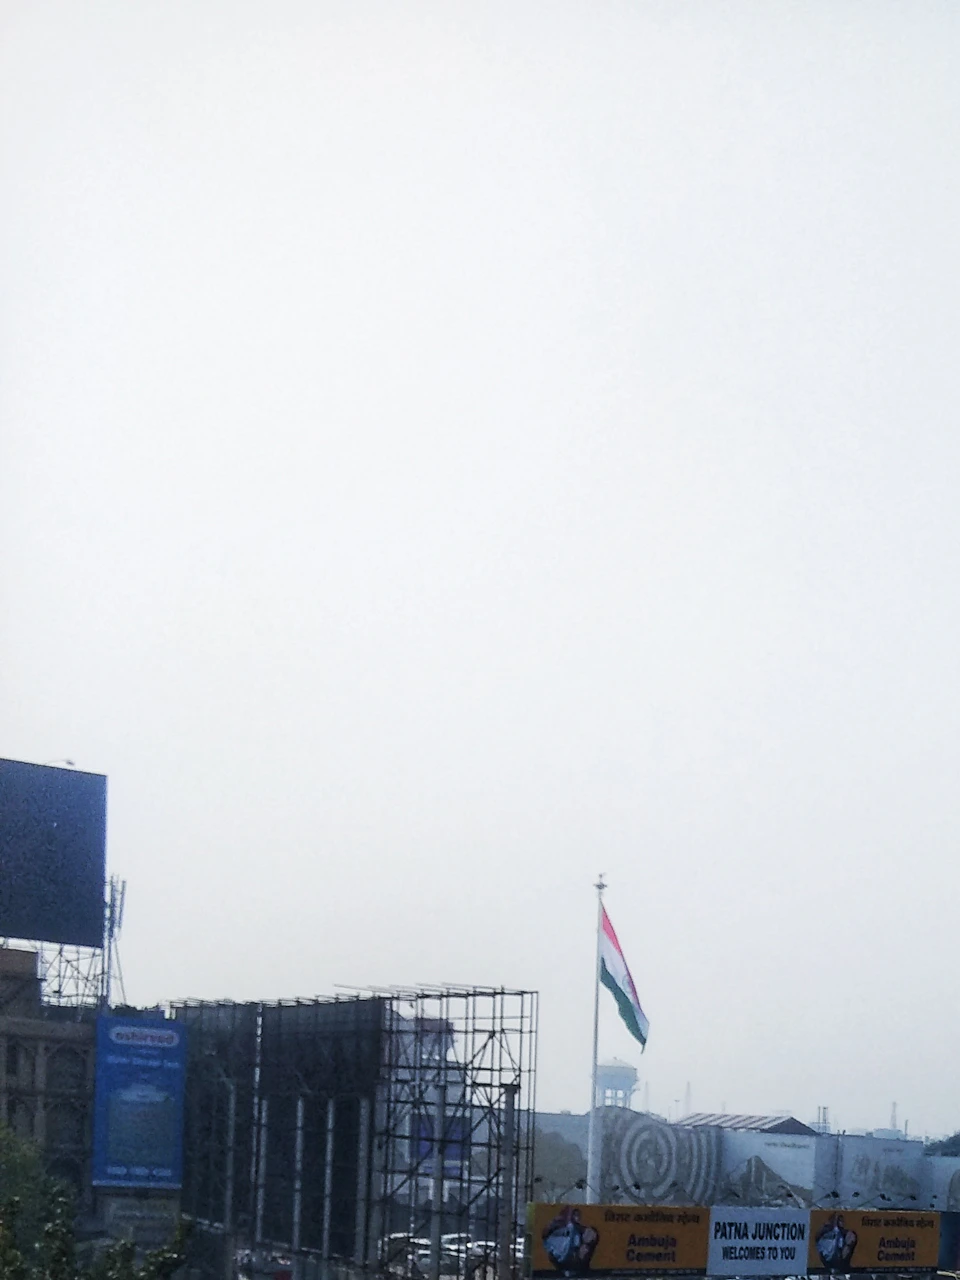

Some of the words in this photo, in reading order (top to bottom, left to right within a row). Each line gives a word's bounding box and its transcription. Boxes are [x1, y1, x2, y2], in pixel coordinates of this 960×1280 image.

[714, 1222, 749, 1240] PATNA
[751, 1222, 805, 1241] JUNCTION
[628, 1234, 677, 1249] Ambuja
[879, 1237, 916, 1250] Ambuja
[626, 1249, 676, 1262] Cement
[722, 1246, 766, 1260] WELCOMES
[768, 1247, 778, 1260] TO
[780, 1247, 796, 1260] YOU
[877, 1250, 915, 1262] Cement
